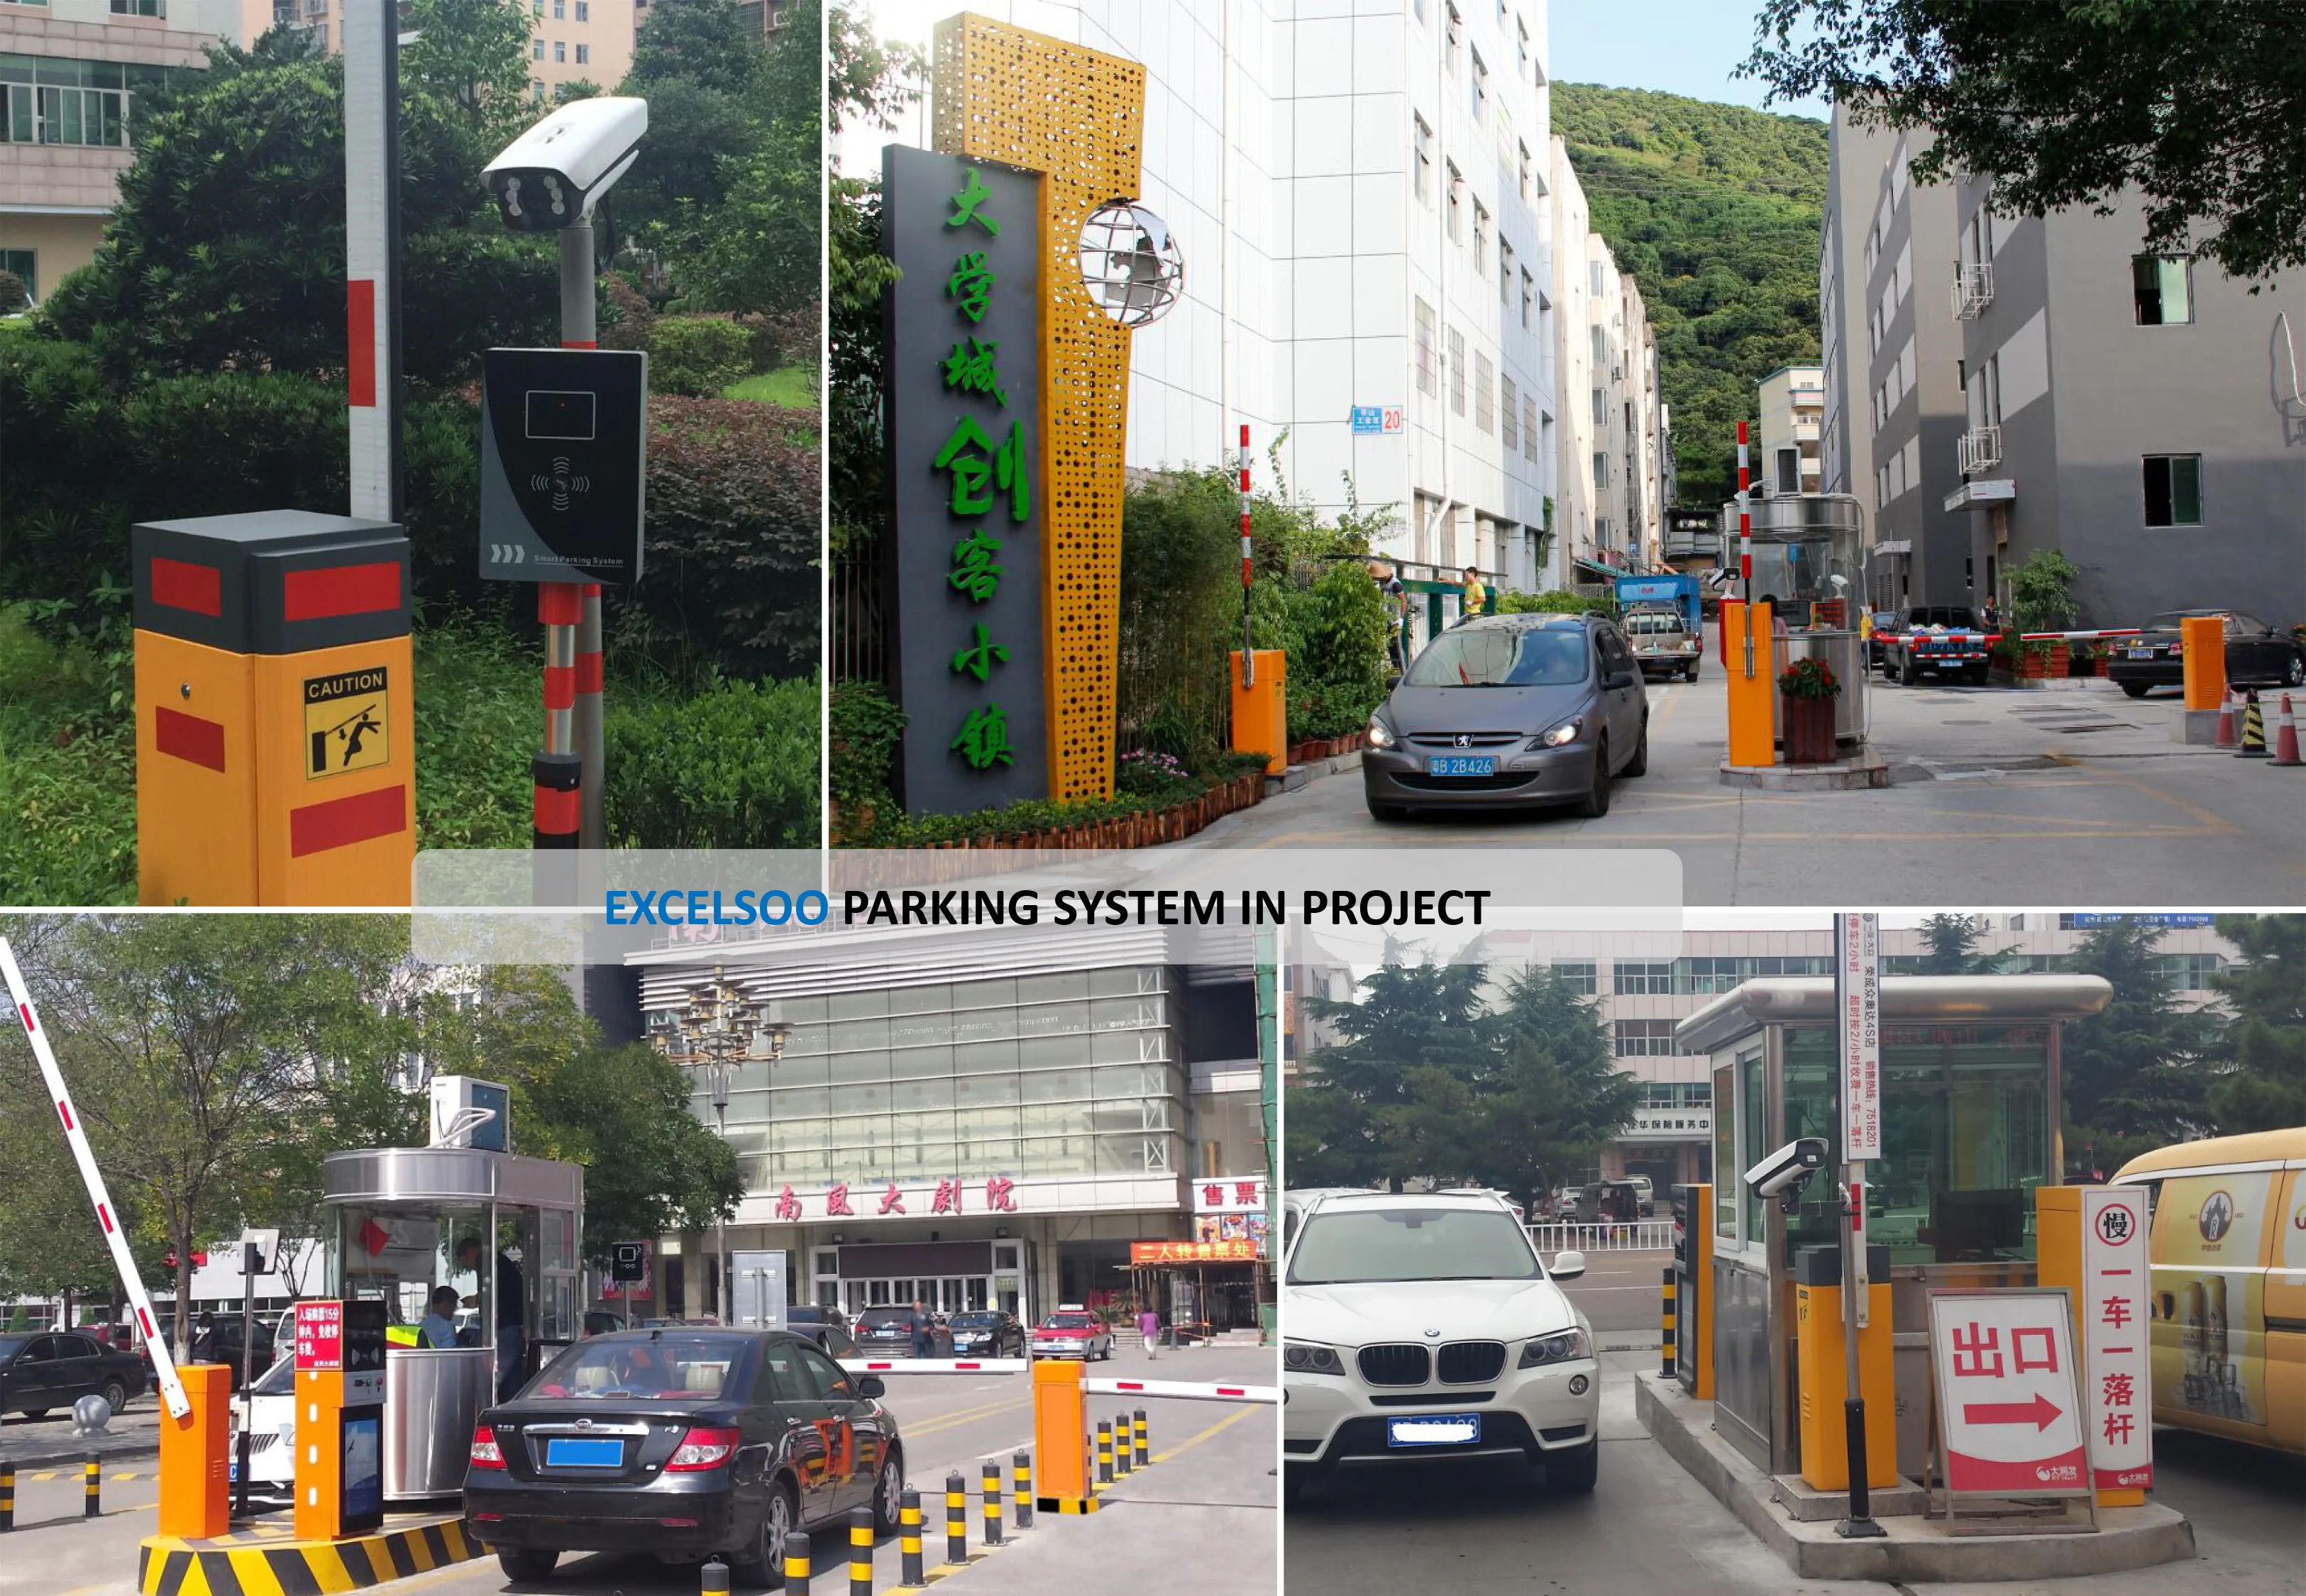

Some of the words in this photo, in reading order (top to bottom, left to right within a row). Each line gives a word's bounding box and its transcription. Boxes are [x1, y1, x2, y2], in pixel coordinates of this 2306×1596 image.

[1384, 411, 1400, 428] 20
[934, 167, 1031, 768] 大学城创客小镇
[558, 555, 591, 566] Parking
[592, 556, 623, 565] System
[309, 672, 382, 698] CAUTION
[1452, 759, 1491, 773] 2B426
[1866, 1108, 1876, 1147] 7518201
[1202, 1181, 1258, 1206] 售票
[2102, 1212, 2127, 1239] 慢
[1951, 1321, 2058, 1379] 出口
[2100, 1268, 2134, 1446] 一车一落杆
